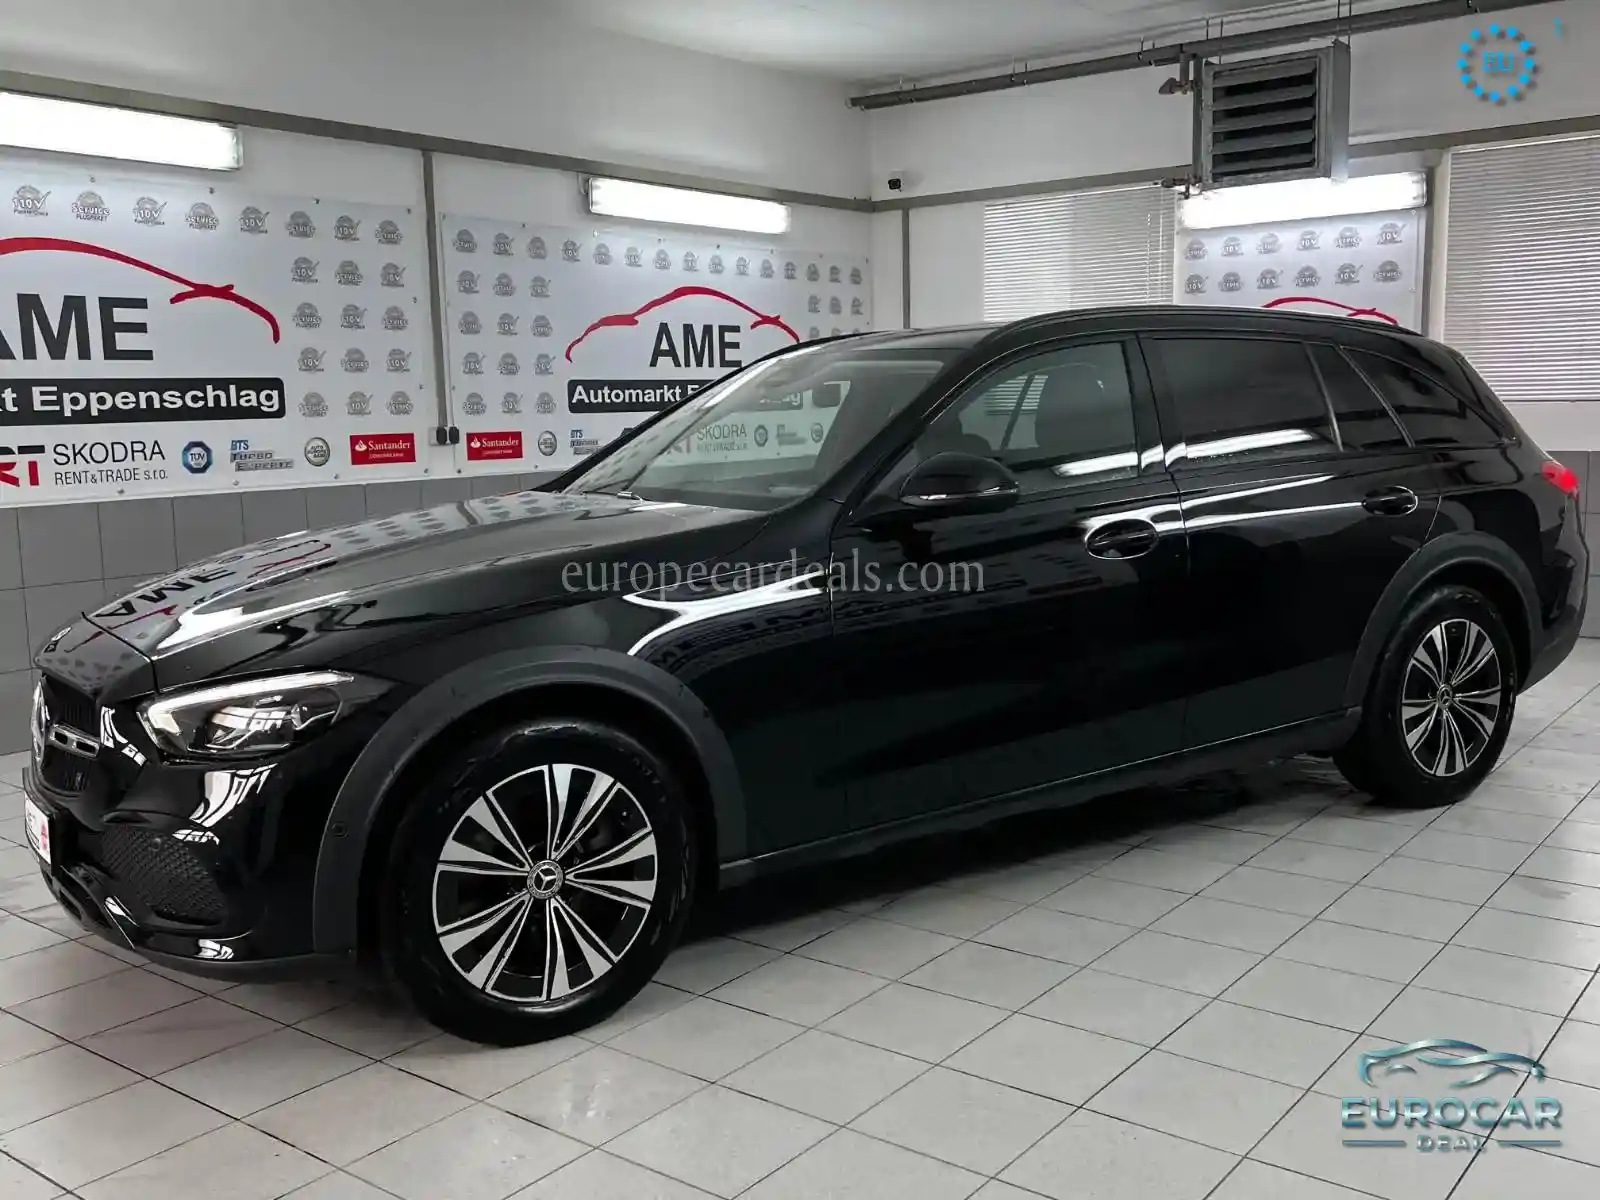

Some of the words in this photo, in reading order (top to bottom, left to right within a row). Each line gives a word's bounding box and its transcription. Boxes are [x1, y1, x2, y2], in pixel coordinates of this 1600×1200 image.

[649, 322, 742, 368] AME
[31, 384, 280, 417] Eppenschlag
[571, 384, 682, 404] Automarkt
[368, 439, 411, 451] Santander
[482, 436, 520, 448] Santander
[53, 440, 166, 466] SKODRA
[54, 467, 141, 486] RENT&TRADE
